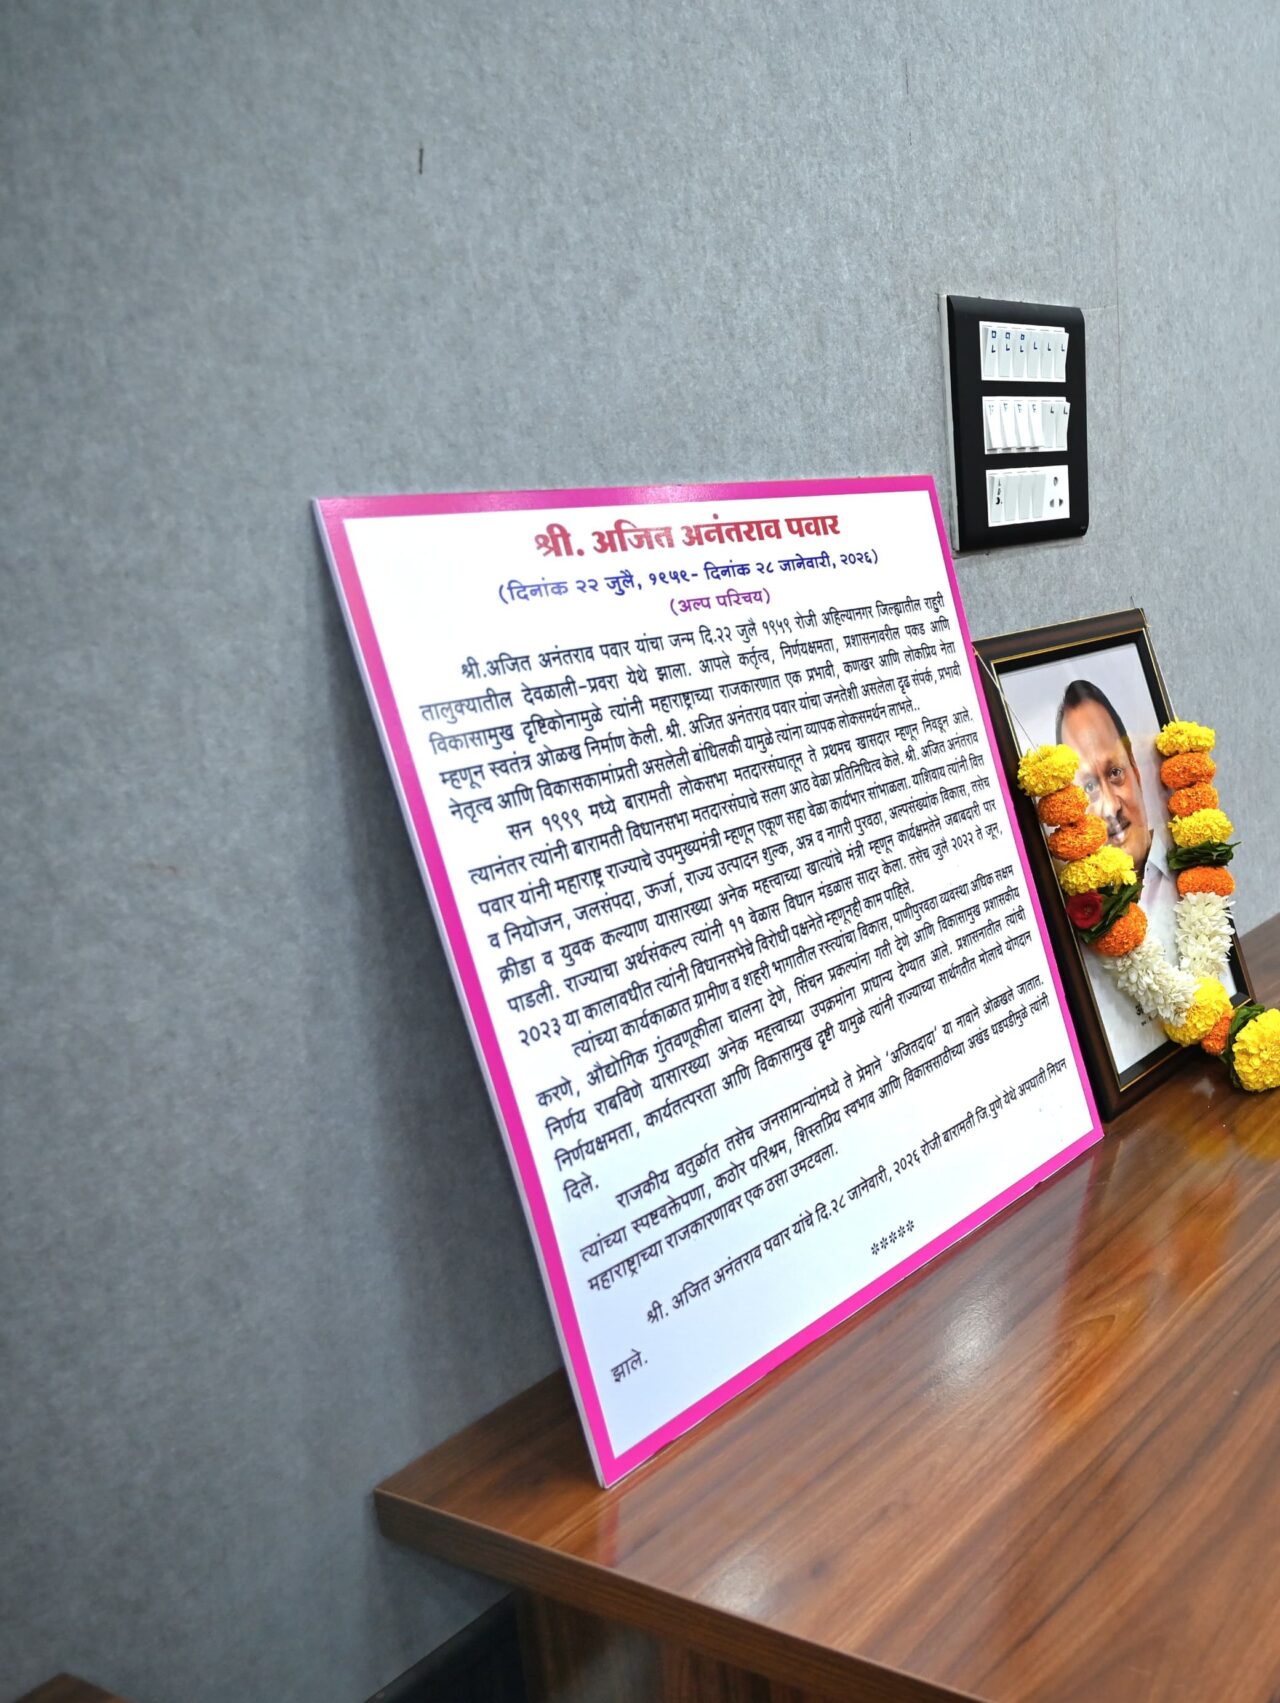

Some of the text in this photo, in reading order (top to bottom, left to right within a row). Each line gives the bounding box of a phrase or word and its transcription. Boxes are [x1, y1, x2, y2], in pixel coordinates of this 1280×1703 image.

[498, 576, 568, 604] (दिनांक
[575, 578, 598, 593] २२
[603, 568, 642, 596] जुलै,
[703, 559, 751, 580] दिनांक
[755, 561, 774, 574] २८
[777, 550, 836, 571] जानेवारी,
[839, 548, 878, 565] २०२६)
[534, 513, 840, 557] श्री. अजित अनंतराव पवार
[537, 644, 595, 668] अनंतराव
[598, 640, 631, 659] पवार
[634, 632, 664, 653] यांचा
[667, 631, 695, 647] जन्म
[735, 617, 757, 643] जुलै
[761, 617, 792, 635] १९५९
[793, 608, 817, 629] रोजी
[821, 605, 874, 626] अहिल्यानगर
[875, 595, 921, 617] जिल्ह्यातील
[923, 590, 945, 613] राहुरी
[669, 587, 770, 616] (अल्प परिचय)
[419, 687, 513, 724] तालुक्यातील
[625, 663, 648, 685] येथे
[654, 662, 691, 682] झाला.
[698, 650, 731, 673] आपले
[736, 645, 775, 670] कर्तृत्व,
[779, 638, 838, 659] निर्णयक्षमता,
[842, 623, 900, 648] प्रशासनावरील
[903, 622, 925, 637] पकड
[929, 614, 950, 632] आणि
[428, 638, 956, 754] विकासामुख दृष्टिकोनामुळे त्यांनी महाराष्ट्राच्या राजकारणात एक प्रभावी, कणखर आणि लोकप्रिय नेता
[448, 796, 494, 823] नेतृत्व
[496, 782, 535, 809] आणि
[535, 757, 640, 800] विकासकामांप्रती
[641, 746, 691, 775] असलेली
[690, 734, 743, 763] बांधिलकी
[742, 727, 774, 753] यामुळे
[774, 722, 804, 743] त्यांना
[803, 717, 836, 734] व्यापक
[836, 702, 887, 728] लोकसमर्थन
[505, 705, 973, 840] सन १९९९ मध्ये बारामती लोकसभा मतदारसंघातून ते प्रथमच खासदार म्हणून निवडून आले.
[506, 822, 1002, 1012] पाडली. राज्याचा अर्थसंकल्प त्यांनी ११ वेळास विधान मंडळास सादर केला. तसेच जुलै २०२२ ते जून,
[544, 1107, 587, 1140] निर्णय
[593, 1078, 644, 1116] राबविणे
[649, 1052, 711, 1089] यासारख्या
[717, 1035, 749, 1060] अनेक
[808, 986, 857, 1017] उपक्रमांना
[860, 968, 894, 995] प्राधान्य
[896, 954, 926, 978] देण्यात
[930, 940, 952, 961] आले.
[954, 918, 1002, 950] प्रशासनातील
[1004, 904, 1026, 927] त्यांची
[615, 1168, 670, 1208] राजकीय
[723, 1124, 755, 1151] तसेच
[758, 1076, 840, 1131] जनसामान्यांमध्ये
[842, 1070, 853, 1088] ते
[855, 1055, 882, 1082] प्रेमाने
[941, 1021, 953, 1035] या
[954, 1003, 980, 1027] नावाने
[982, 985, 1014, 1014] ओळखले
[1015, 974, 1043, 994] जातात.
[587, 1142, 838, 1290] महाराष्ट्राच्या राजकारणावर एक ठसा उमटवला.
[647, 1300, 668, 1323] श्री.
[671, 1275, 711, 1309] अजित
[713, 1244, 762, 1284] अनंतराव
[763, 1226, 791, 1252] पवार
[791, 1209, 814, 1234] यांचे
[846, 1164, 892, 1200] जानेवारी,
[892, 1149, 920, 1174] २०२६
[919, 1131, 942, 1156] रोजी
[941, 1110, 975, 1142] बारामती
[1002, 1085, 1017, 1104] येथे
[1017, 1066, 1047, 1096] अपघाती
[1046, 1057, 1066, 1078] निधन
[610, 1348, 647, 1382] झाले.
